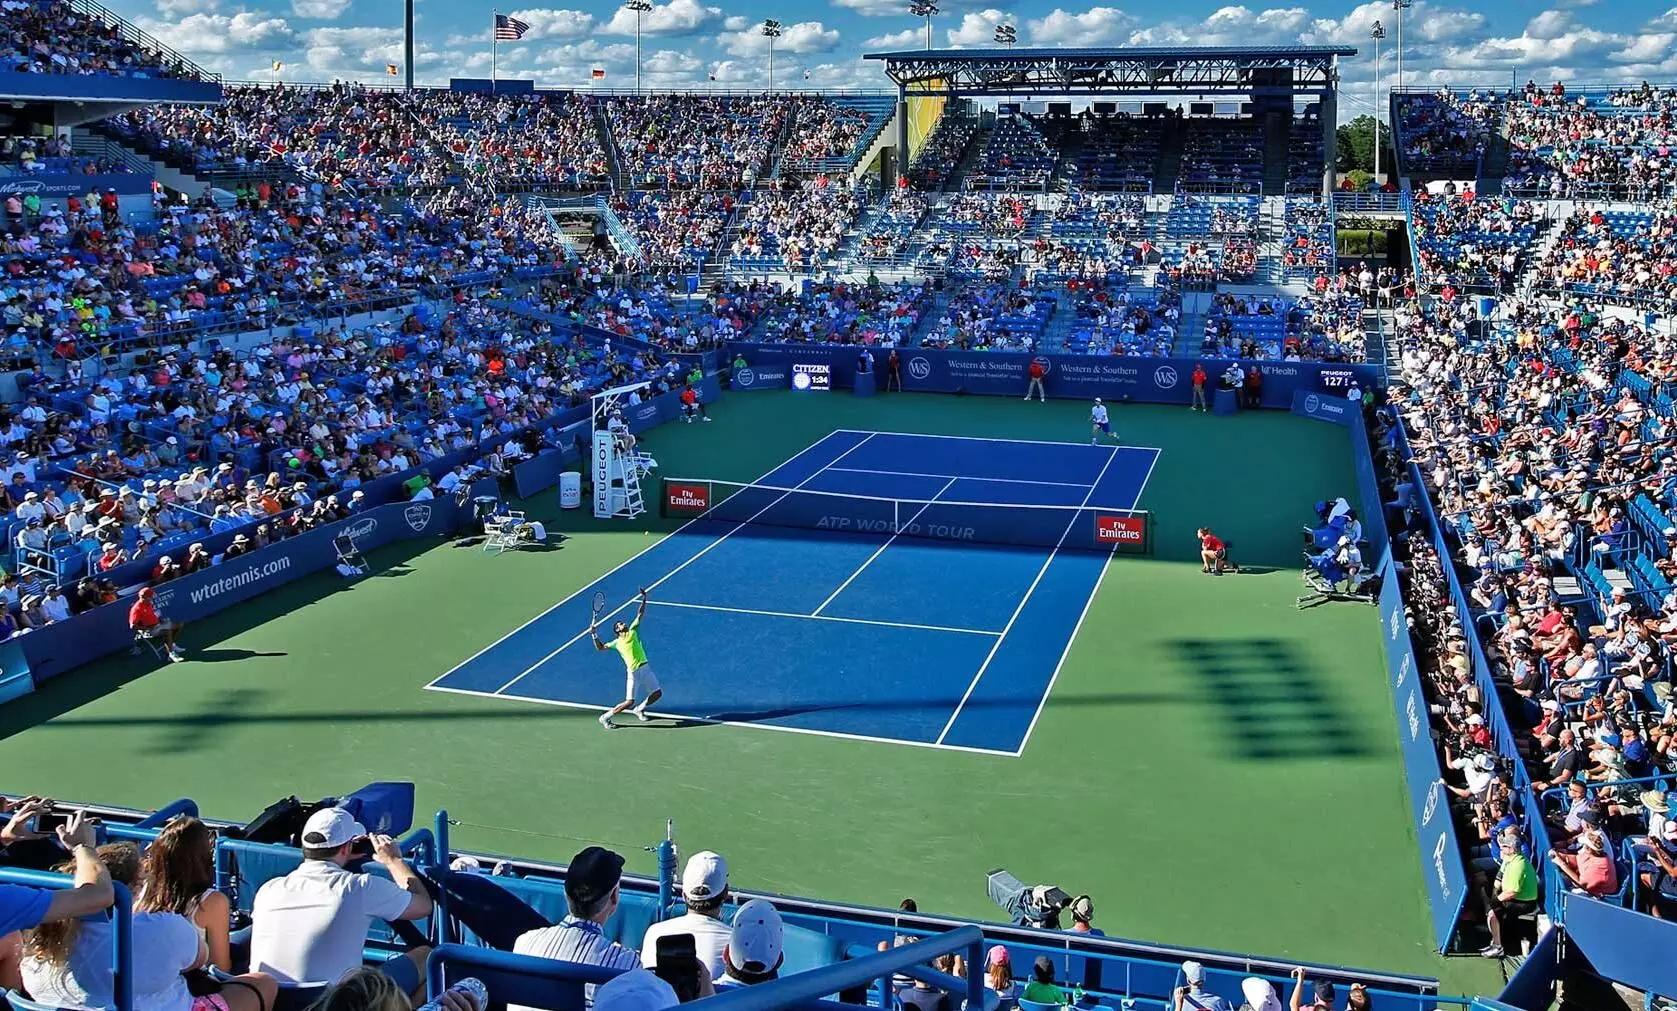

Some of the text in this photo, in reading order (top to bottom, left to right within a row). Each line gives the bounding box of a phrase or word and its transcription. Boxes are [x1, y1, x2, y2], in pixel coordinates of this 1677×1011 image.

[792, 364, 830, 373] CITIZEN
[948, 359, 1023, 371] Western & Southern
[1060, 363, 1138, 375] Western & Southern
[1271, 366, 1298, 376] Health
[811, 375, 829, 384] 1:34
[1324, 376, 1343, 386] 127
[599, 439, 607, 513] PEUGEOT
[670, 496, 706, 507] Emirates
[816, 515, 976, 541] ATP WORLD TOUR
[1098, 527, 1141, 540] Emirates
[190, 554, 290, 604] wtatennis.com
